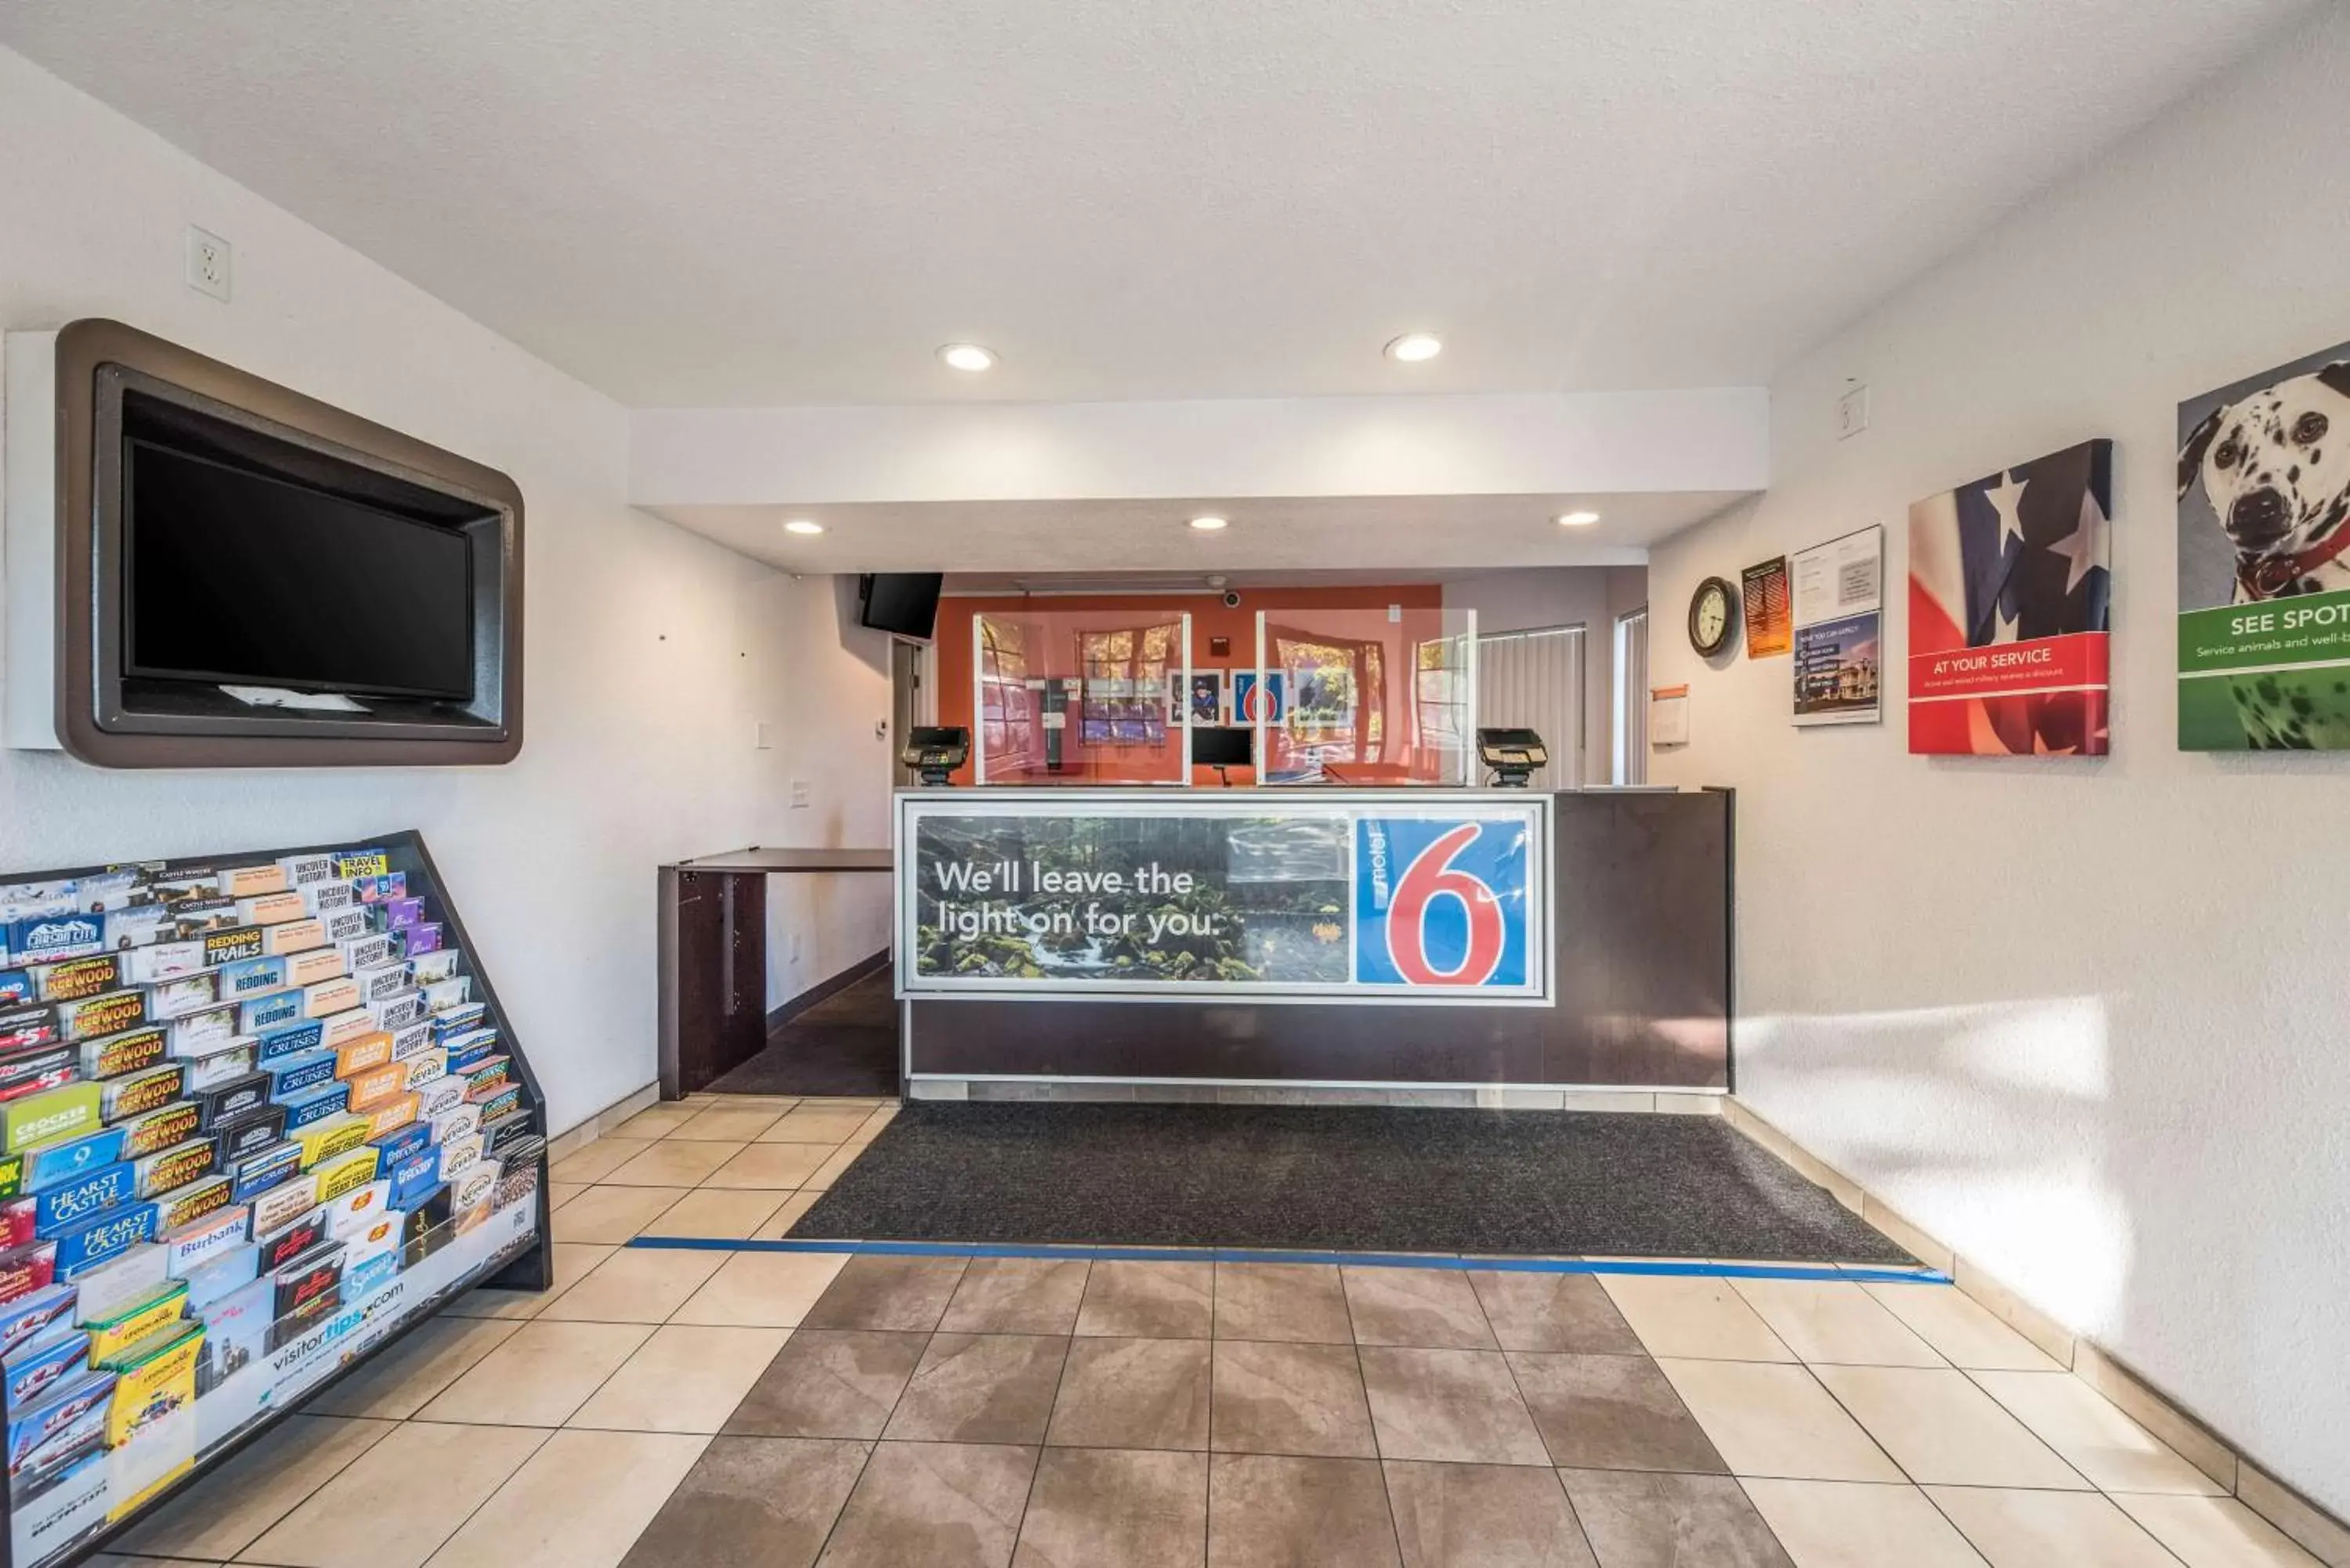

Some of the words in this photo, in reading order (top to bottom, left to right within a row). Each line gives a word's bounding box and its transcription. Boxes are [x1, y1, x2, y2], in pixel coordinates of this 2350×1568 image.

[2231, 614, 2275, 635] SEE
[2196, 645, 2236, 657] Service
[2238, 638, 2282, 653] animals
[2284, 635, 2309, 649] and
[1932, 660, 1950, 674] AT
[1951, 656, 1987, 672] YOUR
[1990, 648, 2052, 668] SERVICE
[344, 855, 381, 869] TRAVEL
[345, 866, 372, 878] INFO
[935, 861, 1019, 893] We'll
[1032, 861, 1123, 894] leave
[1134, 862, 1194, 894] the
[1385, 821, 1506, 985] 6
[938, 901, 1018, 942] light
[1029, 912, 1073, 934] on
[1085, 902, 1137, 934] for
[208, 930, 260, 950] REDDING
[209, 942, 261, 964] TRAILS
[47, 966, 114, 992] REDWOOD
[236, 971, 277, 992] REDDING
[74, 1002, 141, 1028] REDWOOD
[255, 1005, 296, 1028] REDDING
[99, 1039, 162, 1069] REDWOOD
[269, 1032, 319, 1056] CRUISES
[283, 1065, 333, 1091] CRUISES
[118, 1078, 179, 1111] REDWOOD
[15, 1104, 87, 1136] CROCKER
[297, 1100, 345, 1125] CRUISES
[134, 1115, 198, 1145] REDWOOD
[150, 1152, 212, 1185] REDWOOD
[50, 1171, 123, 1210] HEARST
[54, 1185, 119, 1221] CASTLE
[84, 1209, 154, 1246] HEARST
[86, 1223, 146, 1256] CASTLE
[181, 1219, 244, 1255] Burbank
